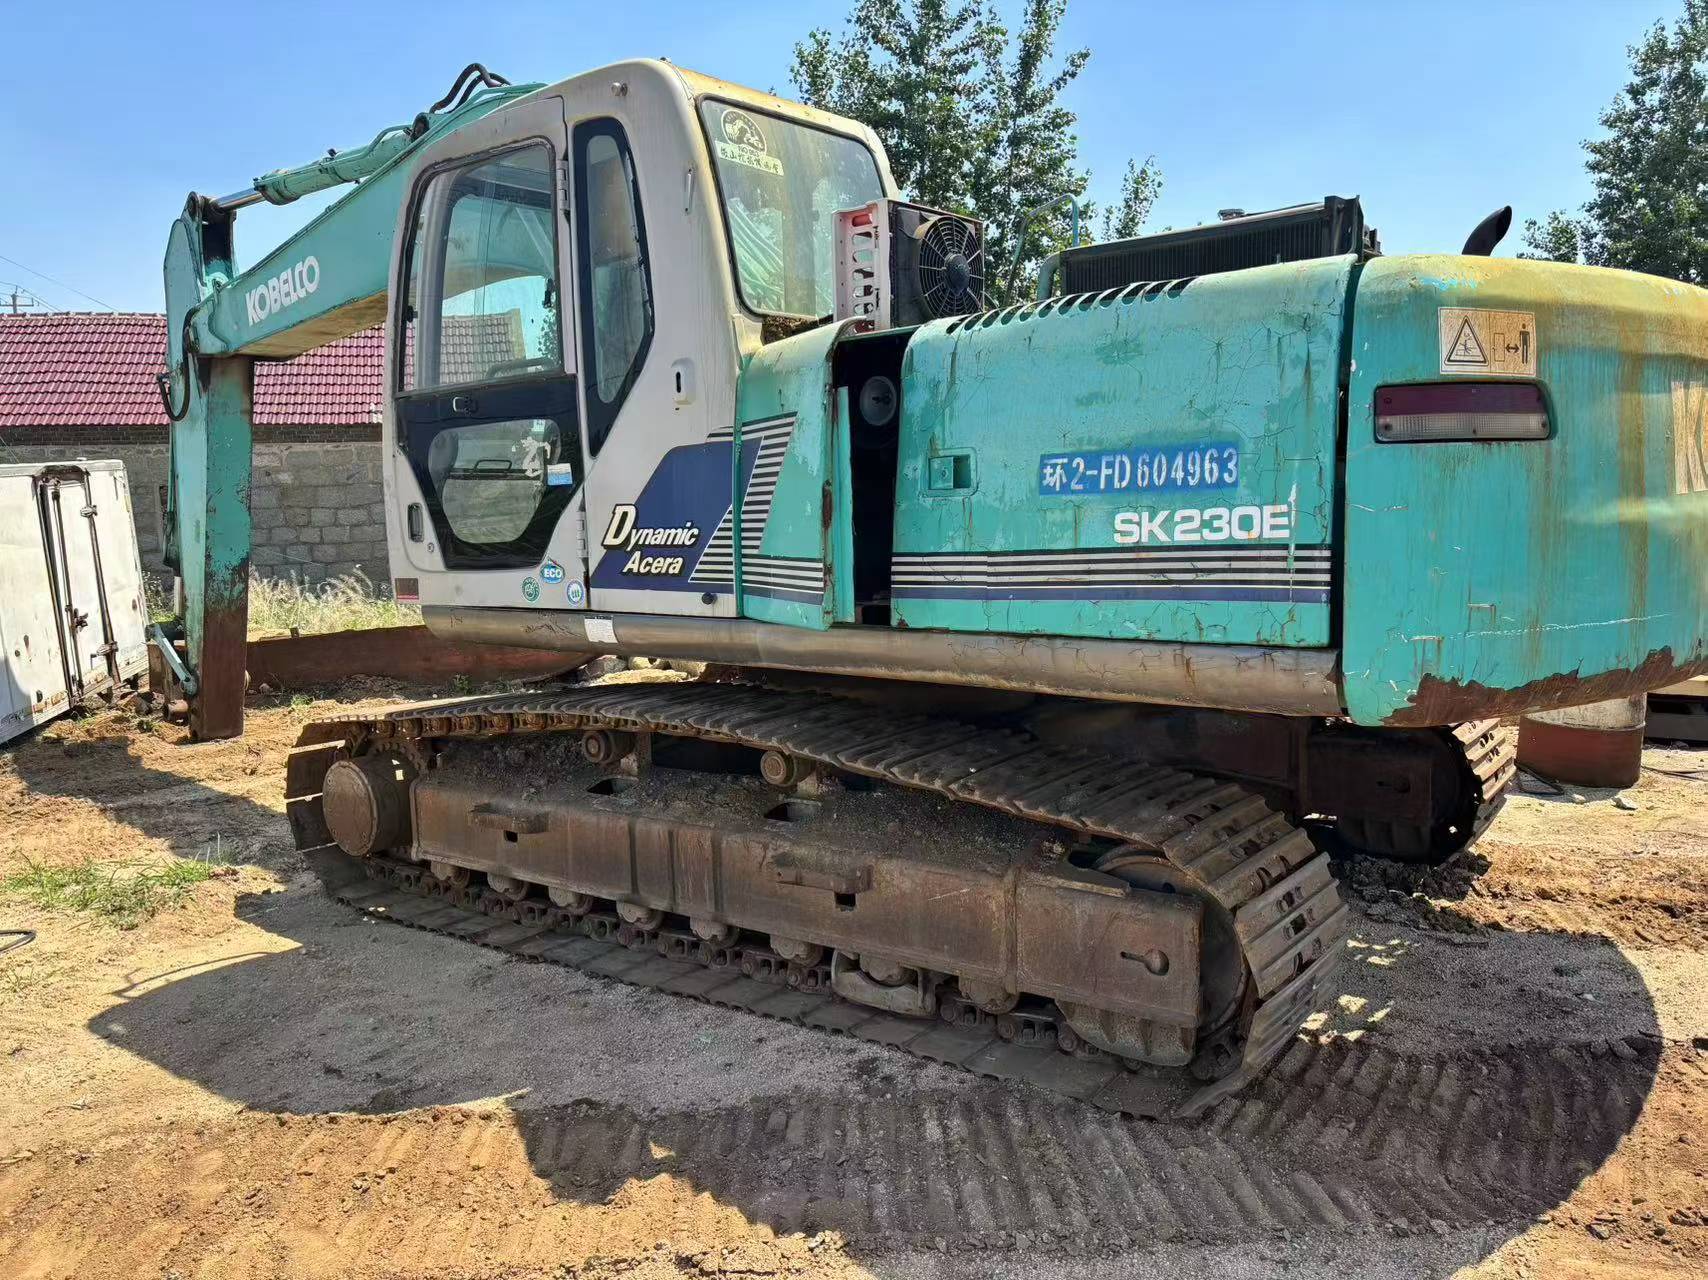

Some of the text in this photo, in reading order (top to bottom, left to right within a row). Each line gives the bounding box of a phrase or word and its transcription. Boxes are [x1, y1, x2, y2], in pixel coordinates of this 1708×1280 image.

[245, 255, 320, 327] KOBELCO
[602, 503, 699, 551] Dynamic
[1114, 504, 1290, 543] SK230E
[543, 568, 562, 578] ECO
[622, 551, 684, 574] Acera
